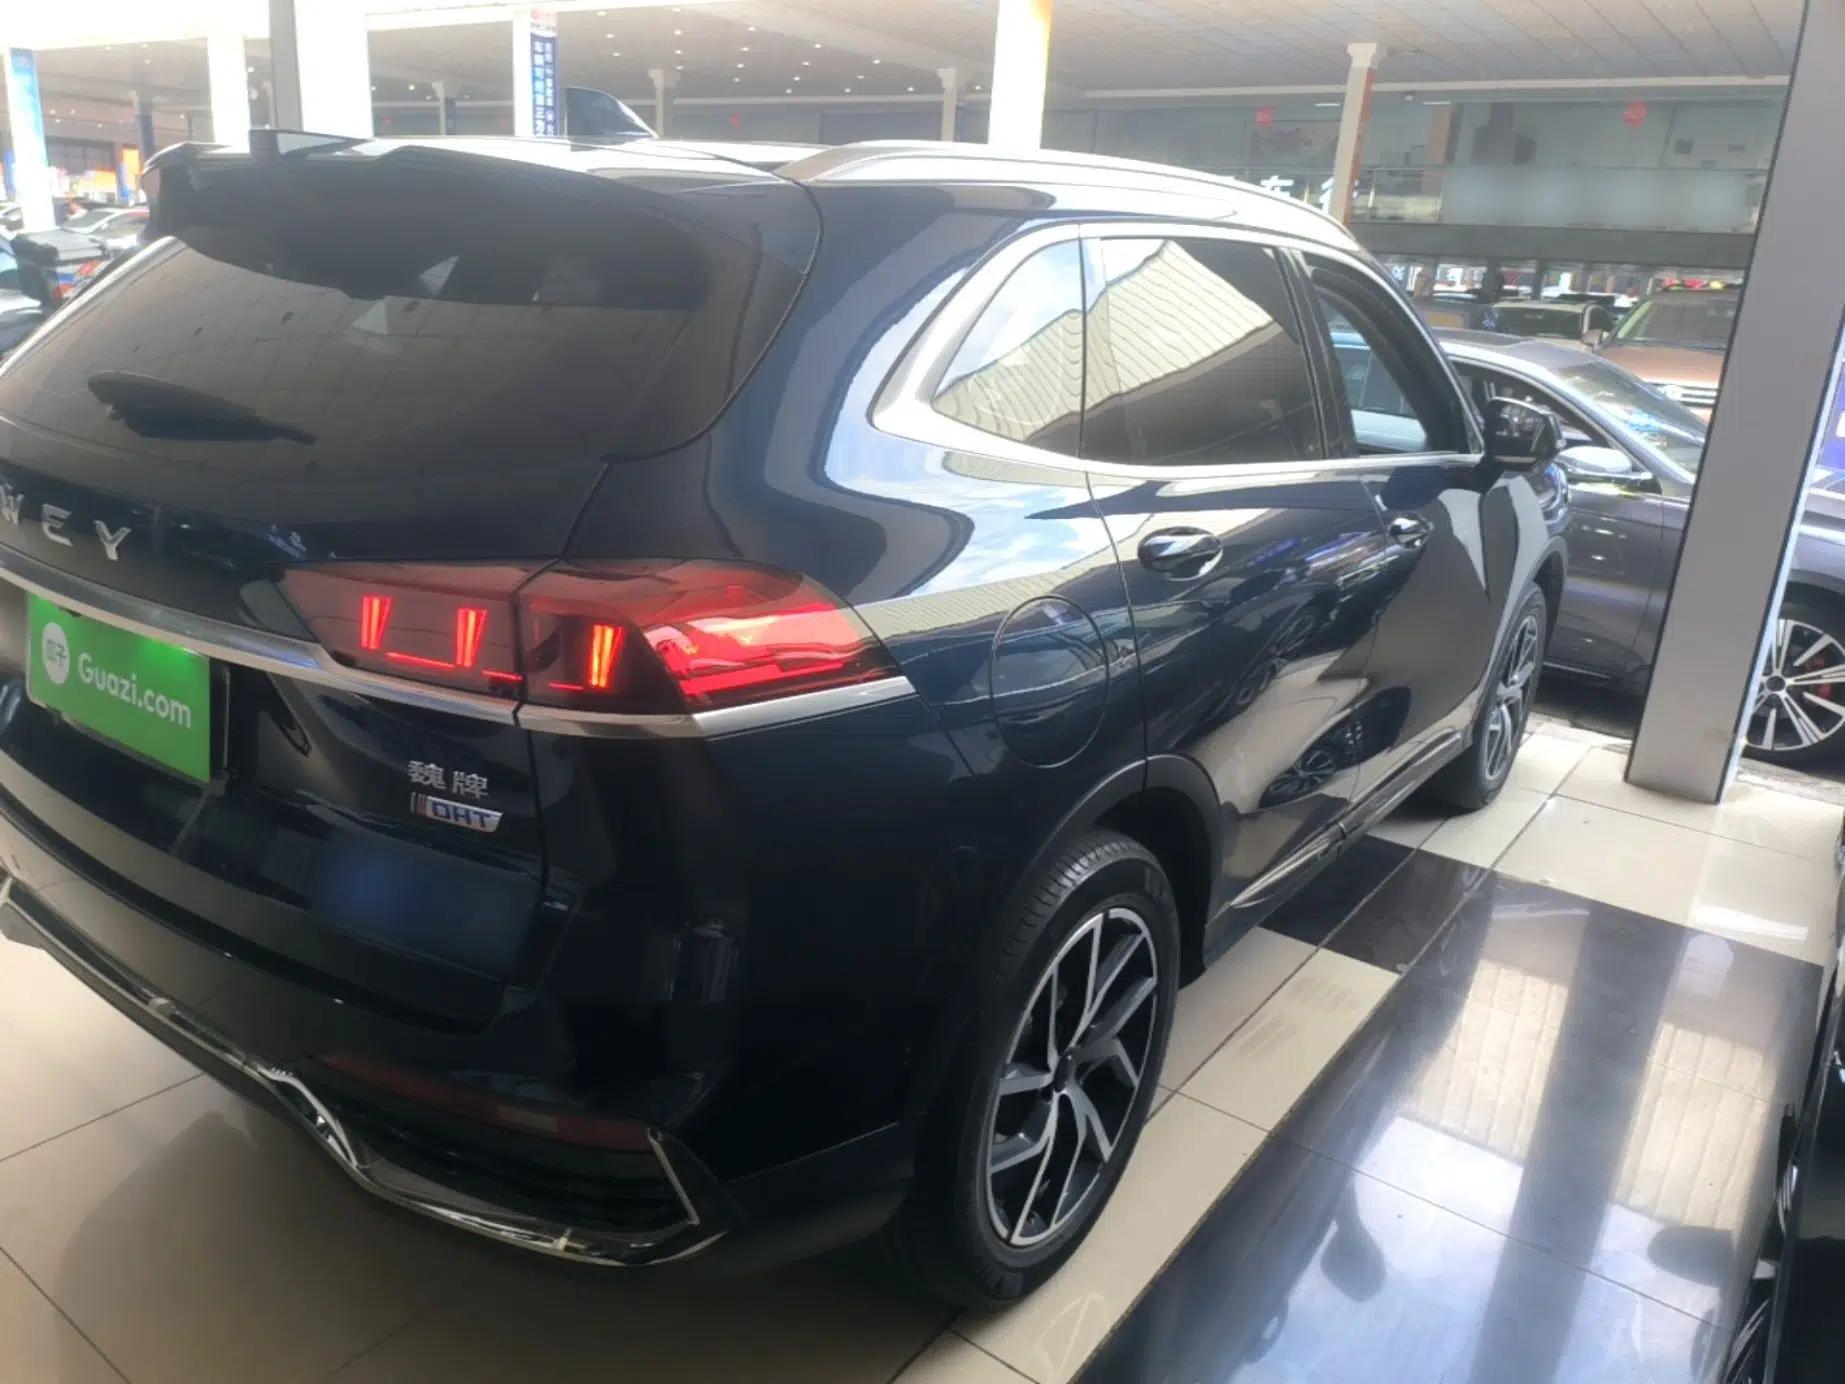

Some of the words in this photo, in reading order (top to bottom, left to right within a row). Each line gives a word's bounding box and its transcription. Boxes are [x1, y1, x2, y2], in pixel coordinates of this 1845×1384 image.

[0, 485, 132, 561] WEY
[79, 653, 191, 729] Guazi.com
[408, 760, 488, 799] 魏牌
